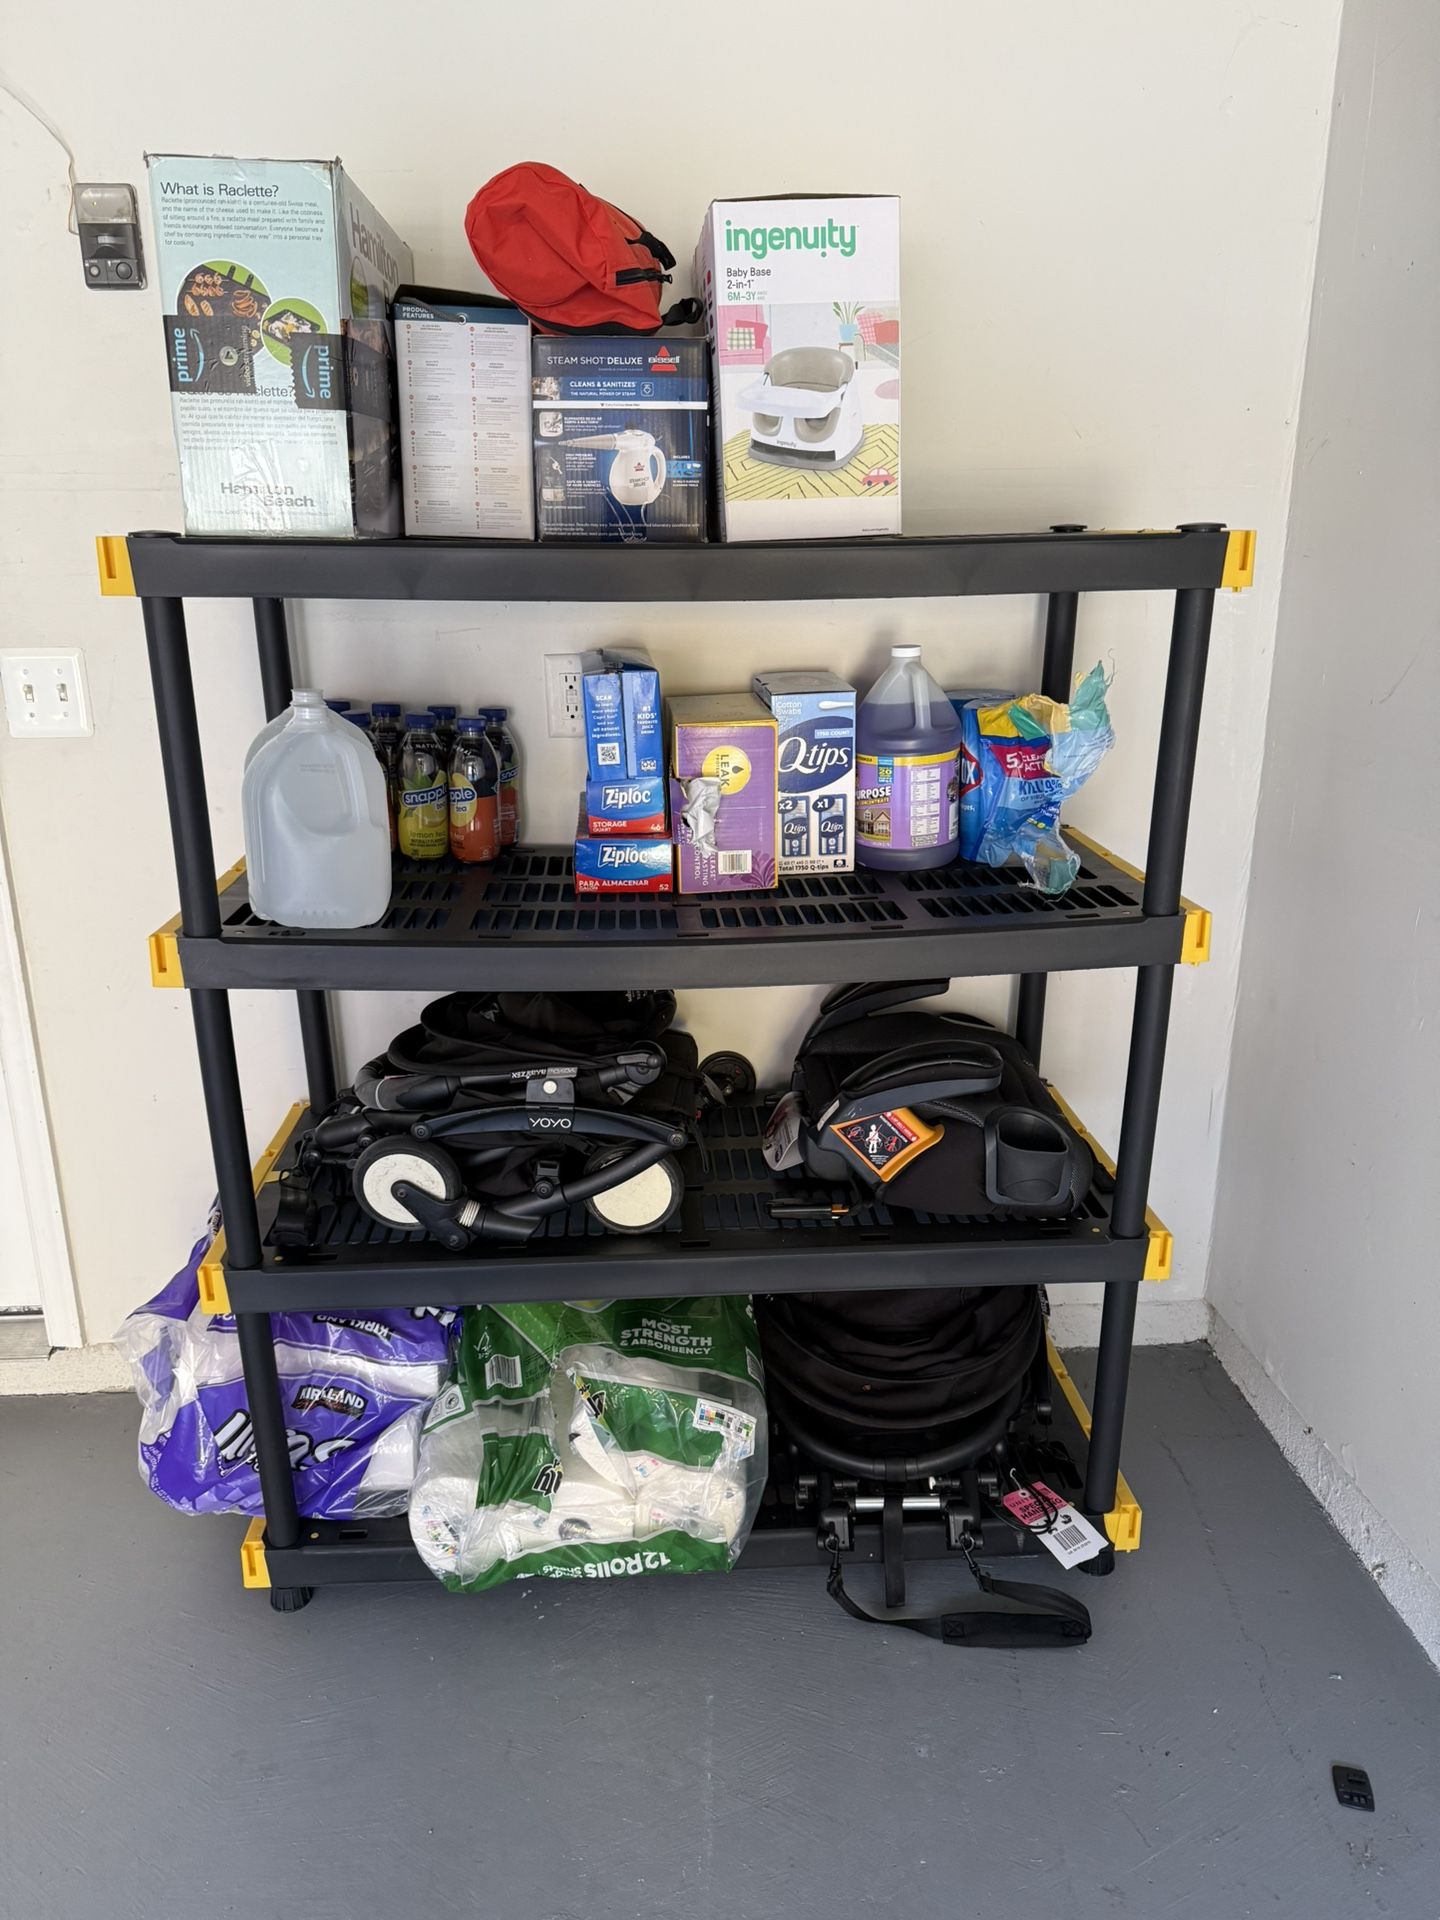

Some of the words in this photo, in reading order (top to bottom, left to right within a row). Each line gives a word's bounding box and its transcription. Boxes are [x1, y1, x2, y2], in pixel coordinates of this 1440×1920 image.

[160, 181, 199, 196] What
[203, 183, 215, 196] is
[218, 184, 279, 198] Raclette?
[350, 201, 400, 286] Hamilton
[725, 217, 857, 260] ingenuity
[726, 268, 748, 278] Baby
[750, 268, 771, 277] Base
[172, 327, 194, 383] prime
[547, 356, 578, 365] STEAM
[581, 356, 605, 365] SHOT
[607, 356, 643, 364] DELUXE
[314, 345, 332, 399] prime
[220, 482, 295, 495] Hamton
[264, 496, 315, 507] Beach
[1006, 752, 1018, 769] 5
[1024, 762, 1044, 772] ACTI
[500, 770, 518, 781] snap
[719, 754, 730, 788] LEAK
[404, 784, 448, 804] snappl
[450, 790, 473, 800] pple
[605, 788, 651, 809] Ziploc
[856, 786, 892, 800] URPOSE
[779, 801, 793, 810] x2
[817, 798, 828, 808] x1
[602, 847, 649, 868] Ziploc
[529, 1118, 571, 1128] YOYO
[316, 1314, 392, 1338] KIRKLAND
[641, 1318, 692, 1335] MOST
[620, 1328, 713, 1347] STRENGTH
[630, 1337, 711, 1355] ABSORBENCY
[583, 1552, 644, 1579] Rolls
[642, 1551, 671, 1569] 12
